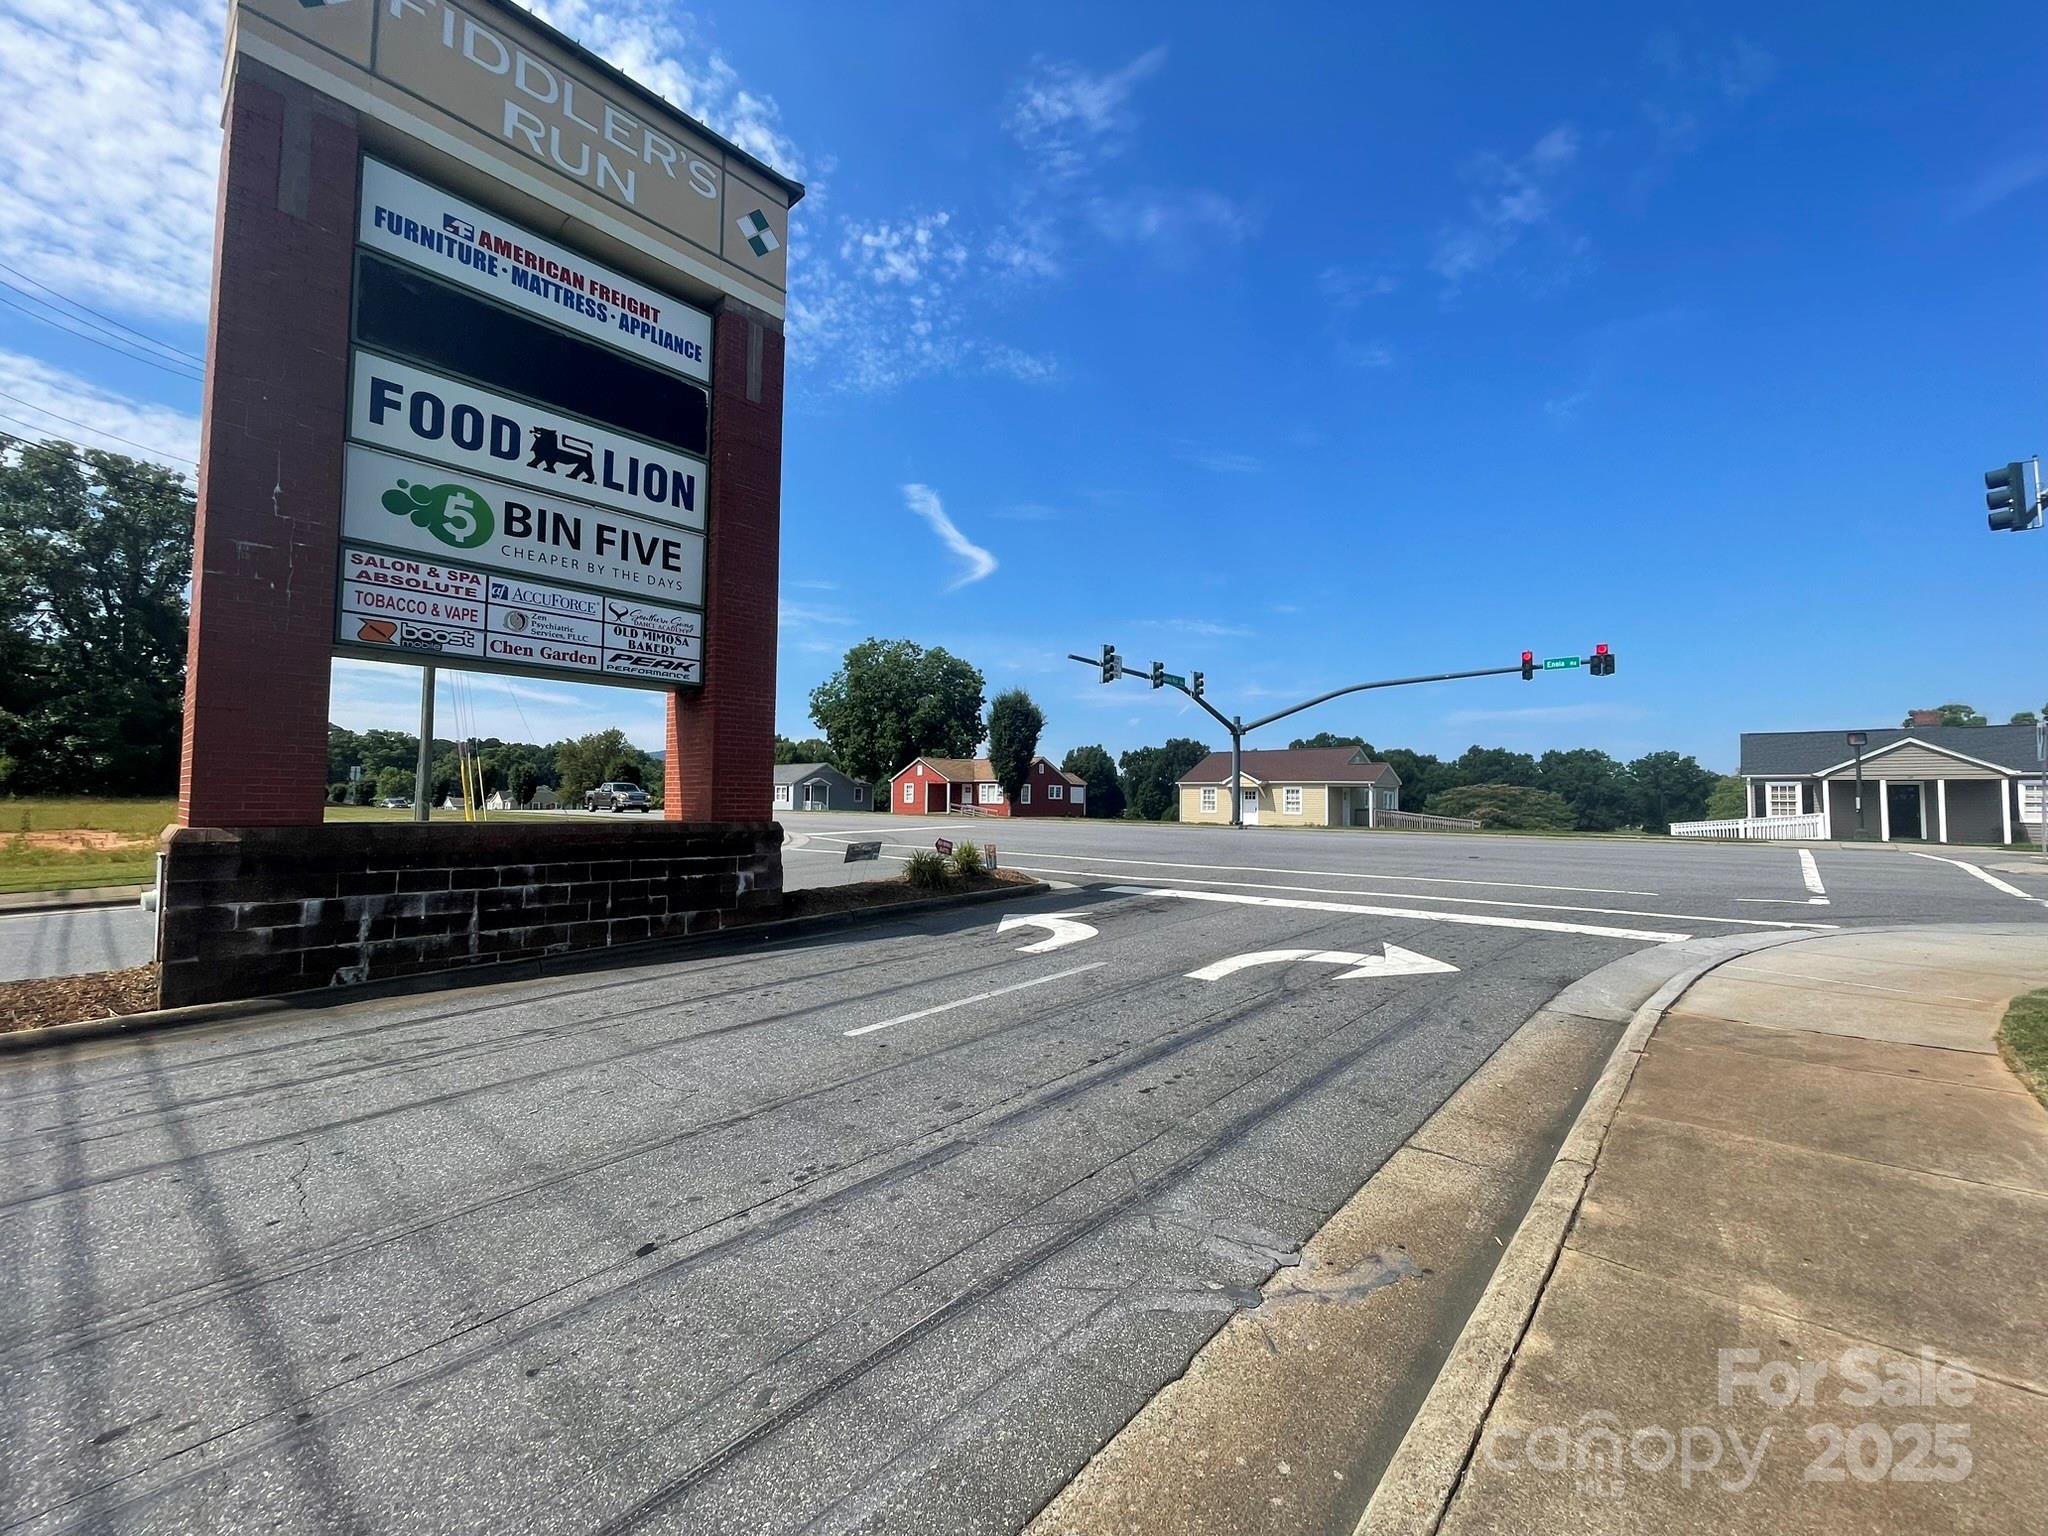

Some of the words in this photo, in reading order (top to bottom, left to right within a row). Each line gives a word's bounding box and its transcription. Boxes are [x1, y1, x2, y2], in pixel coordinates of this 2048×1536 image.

[503, 99, 636, 206] RUN
[374, 205, 499, 277] FURNITURE
[511, 266, 607, 323] MATTRESS
[618, 313, 703, 363] APPLIANCE
[478, 230, 585, 291] AMERICAN
[589, 279, 661, 323] FREIGHT
[369, 376, 521, 461] FOOD
[603, 449, 696, 512] LION
[503, 501, 581, 551] BIN
[595, 523, 682, 573] FIVE
[351, 553, 420, 574] SALON
[427, 567, 440, 578] &
[447, 570, 481, 585] SPA
[501, 545, 580, 570] CHEAPER
[587, 562, 605, 576] BY
[612, 567, 640, 582] THE
[647, 575, 683, 591] DAYS
[356, 570, 478, 598] ABSOLUTE
[355, 590, 427, 615] TOBACCO
[431, 603, 441, 617] &
[445, 605, 479, 623] VAPE
[532, 613, 547, 621] Zen
[401, 622, 474, 648] boost
[531, 621, 575, 633] Psychiatric
[567, 633, 589, 643] PLLC
[613, 625, 638, 638] OLD
[642, 631, 689, 647] MIMOSA
[658, 624, 691, 634] ACADEMY
[402, 639, 442, 651] mobile
[490, 640, 534, 657] Chen
[540, 646, 598, 665] Garden
[628, 640, 676, 655] BAKERY
[606, 665, 691, 680] PERFORMANCE
[608, 653, 696, 673] PEAK
